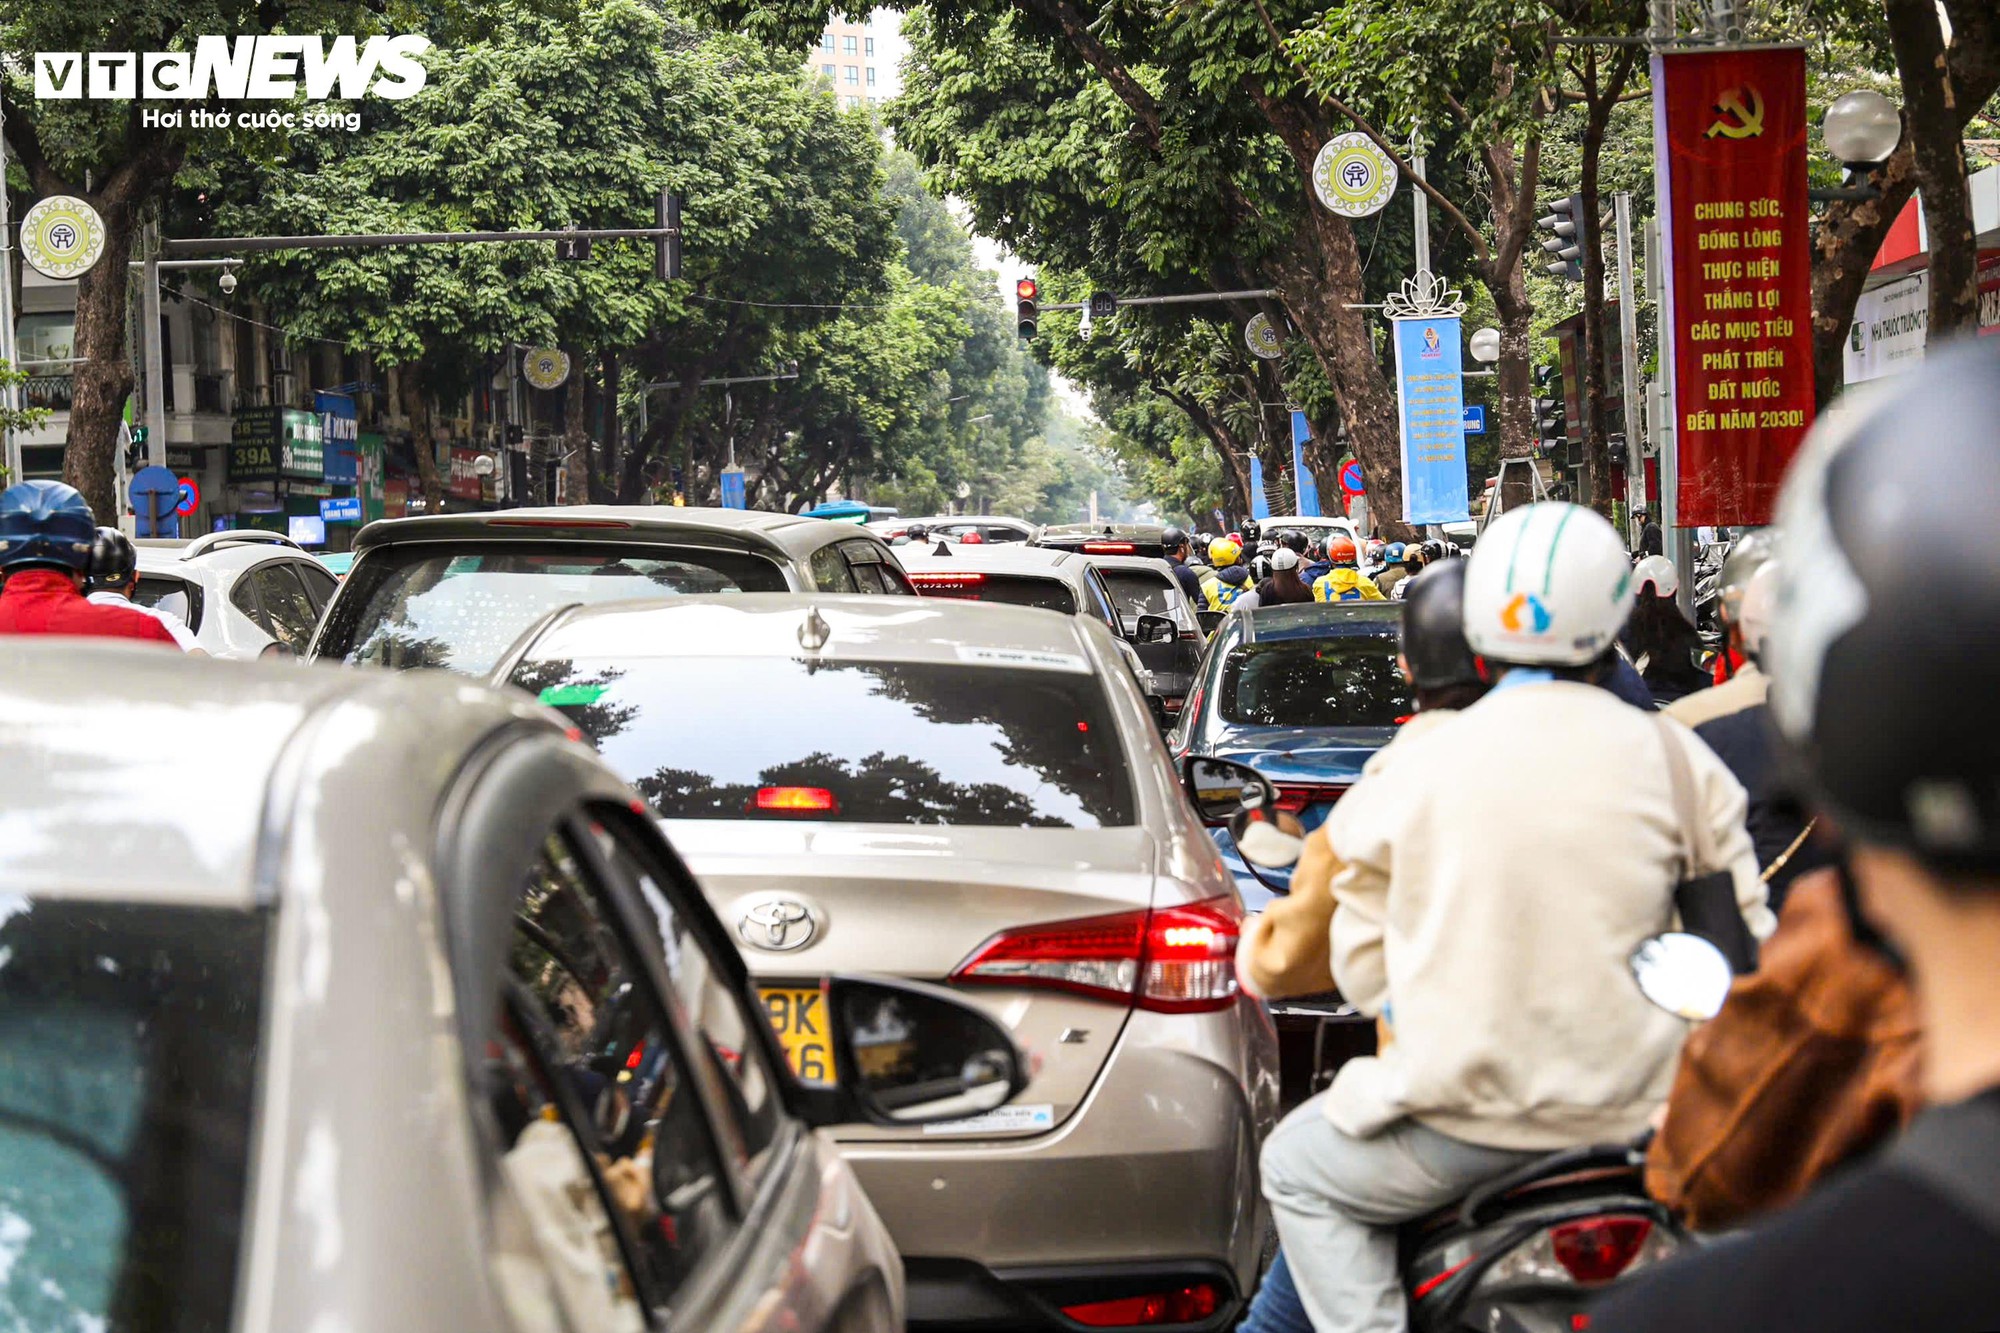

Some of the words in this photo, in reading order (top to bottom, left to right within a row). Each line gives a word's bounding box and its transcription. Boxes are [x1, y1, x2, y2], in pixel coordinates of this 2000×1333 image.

[1695, 201, 1744, 220] CHUNG
[1744, 227, 1781, 248] LÒNG
[1702, 260, 1742, 282] THỰC
[1746, 256, 1780, 281] HIỆN
[1704, 286, 1753, 310] THẮNG
[1757, 288, 1780, 310] LỢI
[1691, 320, 1720, 341] CÁC
[1725, 321, 1760, 342] MỤC
[1764, 316, 1793, 338] TIÊU
[1702, 349, 1740, 370] PHÁT
[1745, 346, 1784, 369] TRIỂN
[1708, 379, 1737, 400] ĐẤT
[1741, 377, 1780, 399] NƯỚC
[1463, 419, 1481, 430] RUNG
[1687, 409, 1716, 431] ĐẾN
[1720, 408, 1756, 430] NĂM
[1760, 410, 1803, 428] 2030!
[235, 446, 272, 466] 39A
[766, 993, 820, 1035] 9K
